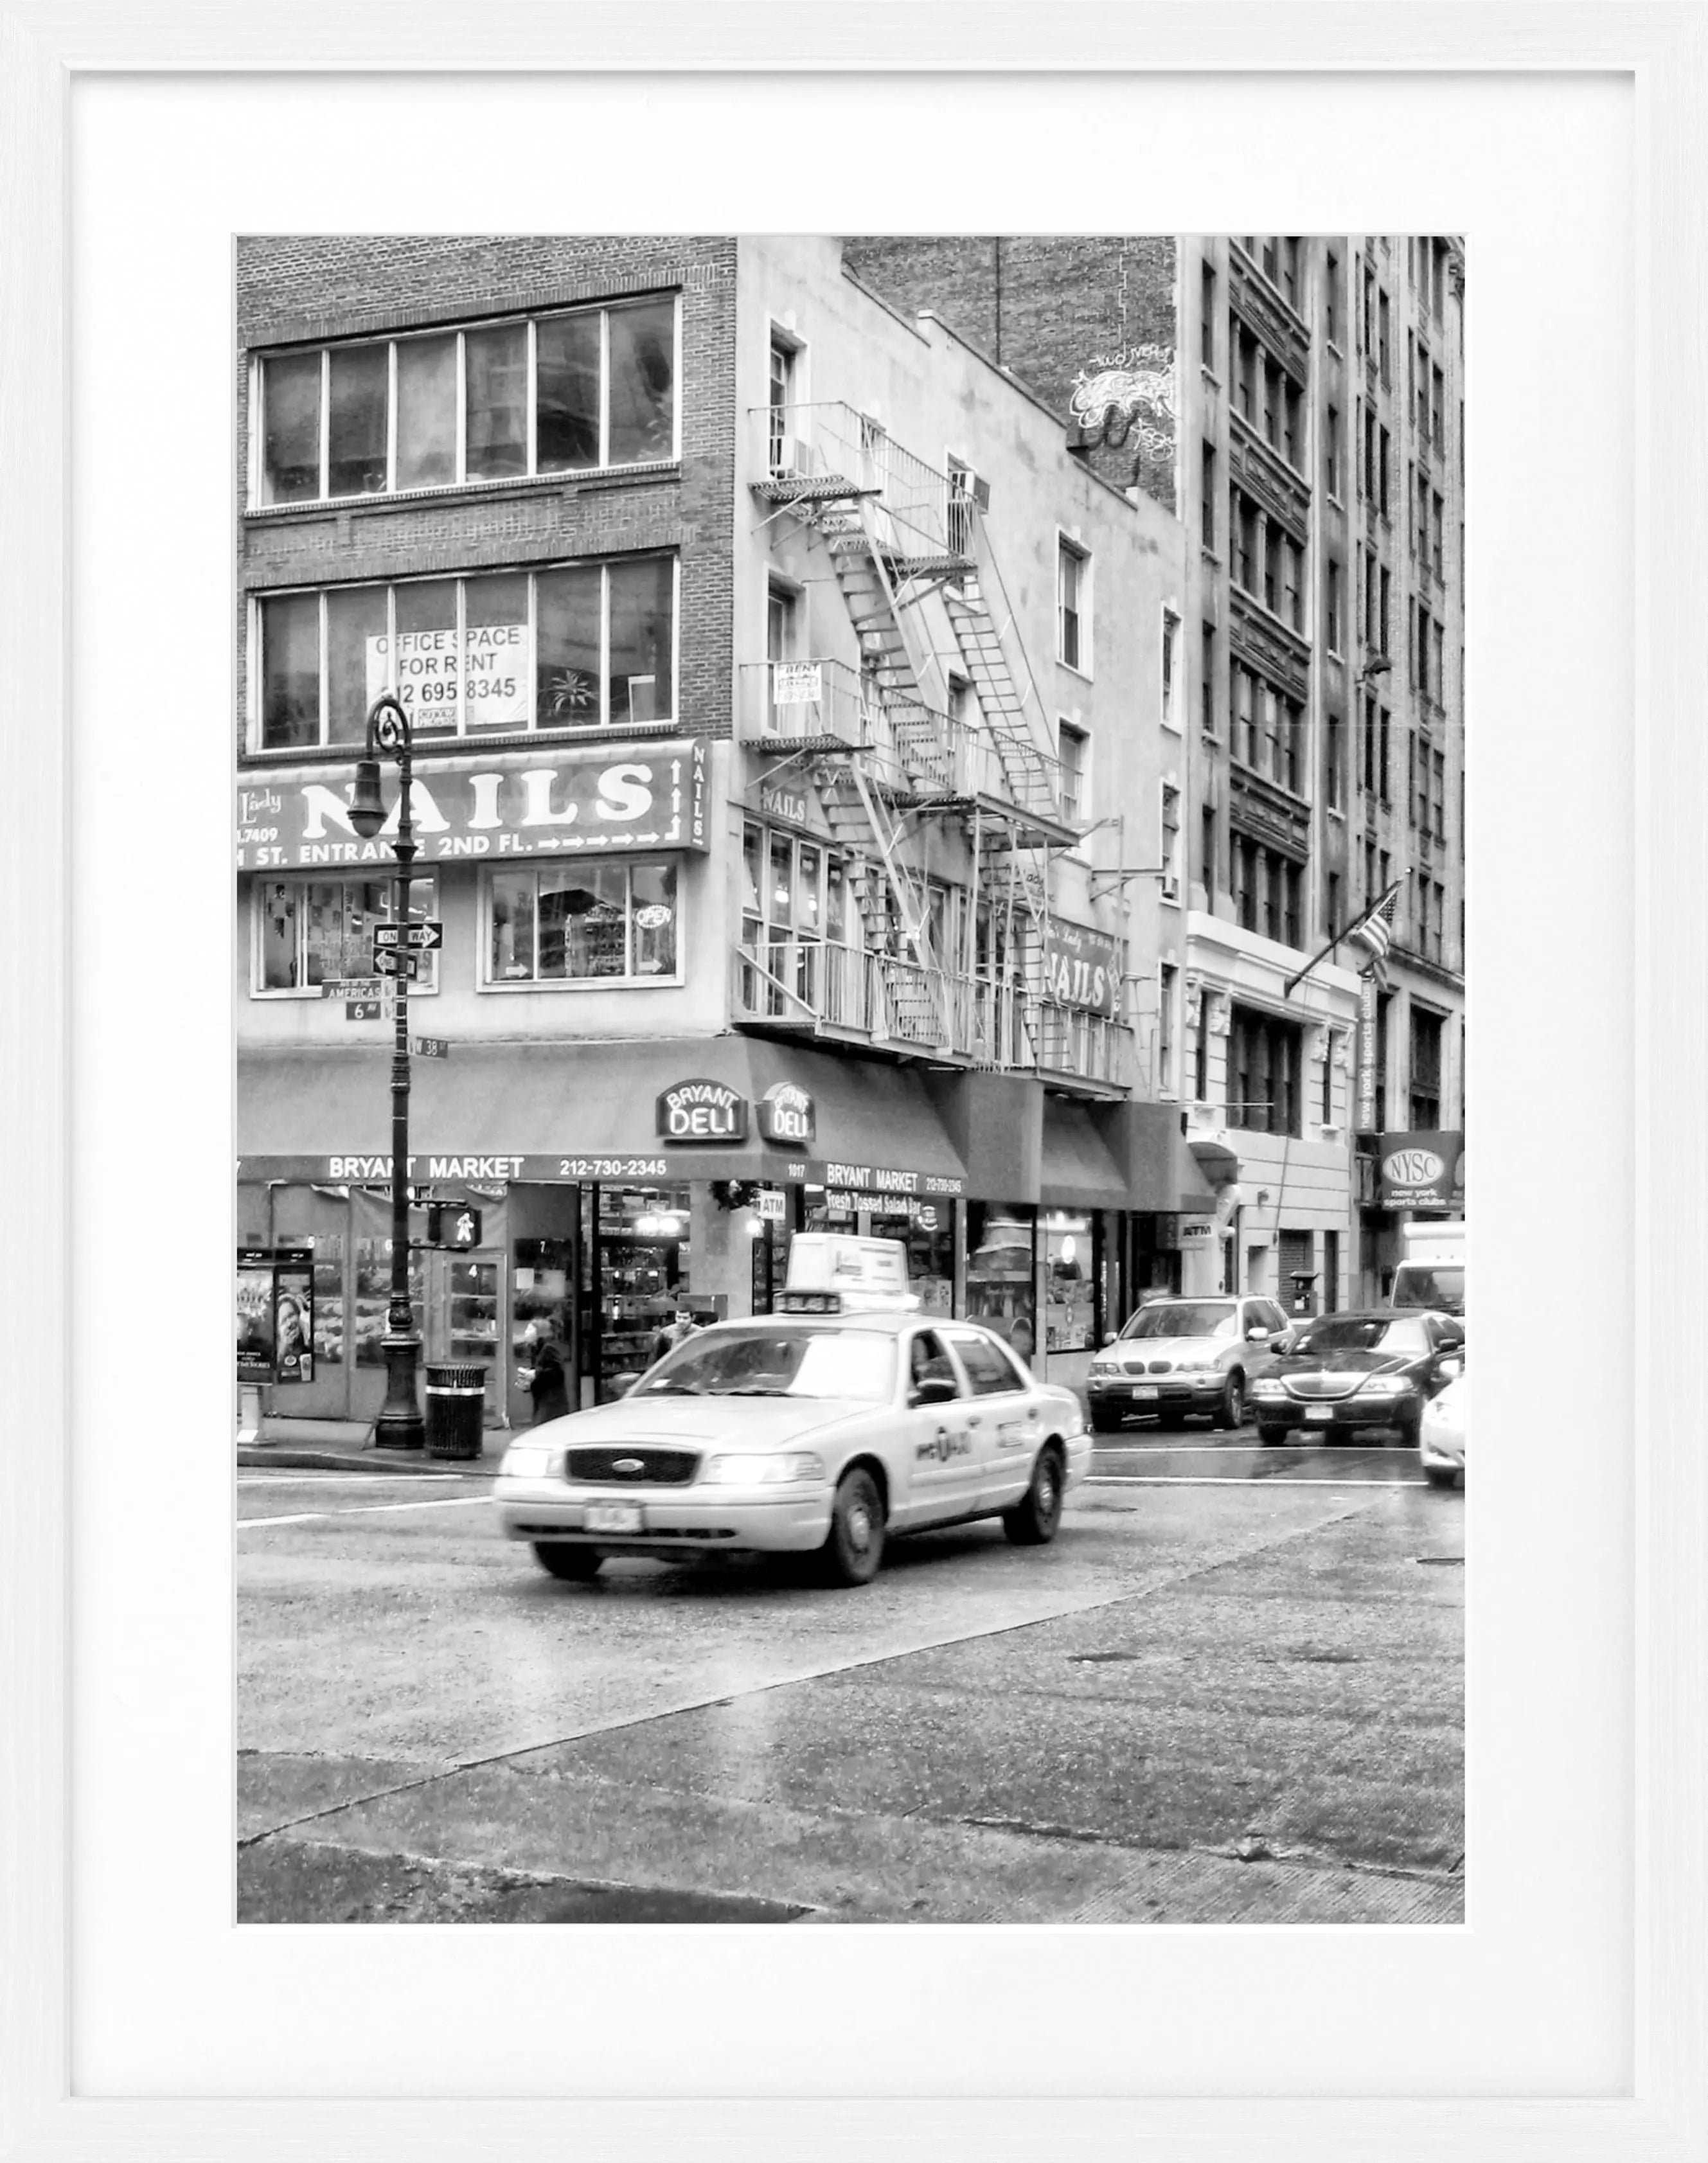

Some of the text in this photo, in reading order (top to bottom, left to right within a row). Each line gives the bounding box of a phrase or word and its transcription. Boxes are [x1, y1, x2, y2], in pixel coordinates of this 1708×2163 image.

[400, 657, 438, 677] FOR
[422, 681, 457, 702] 695
[467, 677, 516, 700] 8345
[301, 764, 654, 839] NAILS
[693, 745, 706, 836] NAILS
[240, 788, 281, 824] Lady
[762, 787, 806, 821] NAILS
[256, 846, 288, 866] ST.
[300, 839, 425, 863] ENTRANE
[438, 835, 490, 856] 2ND
[499, 833, 533, 853] FL.
[411, 931, 432, 941] WAY
[328, 987, 382, 999] AMERICAS
[354, 1004, 364, 1019] 6
[425, 1040, 438, 1056] 38
[1360, 1069, 1373, 1098] york
[666, 1085, 739, 1110] BRYANT
[669, 1107, 734, 1135] DELI
[774, 1108, 807, 1137] DELI
[429, 1157, 525, 1179] MARKET
[560, 1159, 667, 1175] 212-730-2345
[788, 1162, 806, 1178] 1017
[826, 1163, 871, 1188] BRYANT
[876, 1168, 918, 1192] MARKET
[1391, 1152, 1436, 1182] NYSC
[763, 1197, 783, 1213] ATM
[1183, 1225, 1211, 1236] ATM
